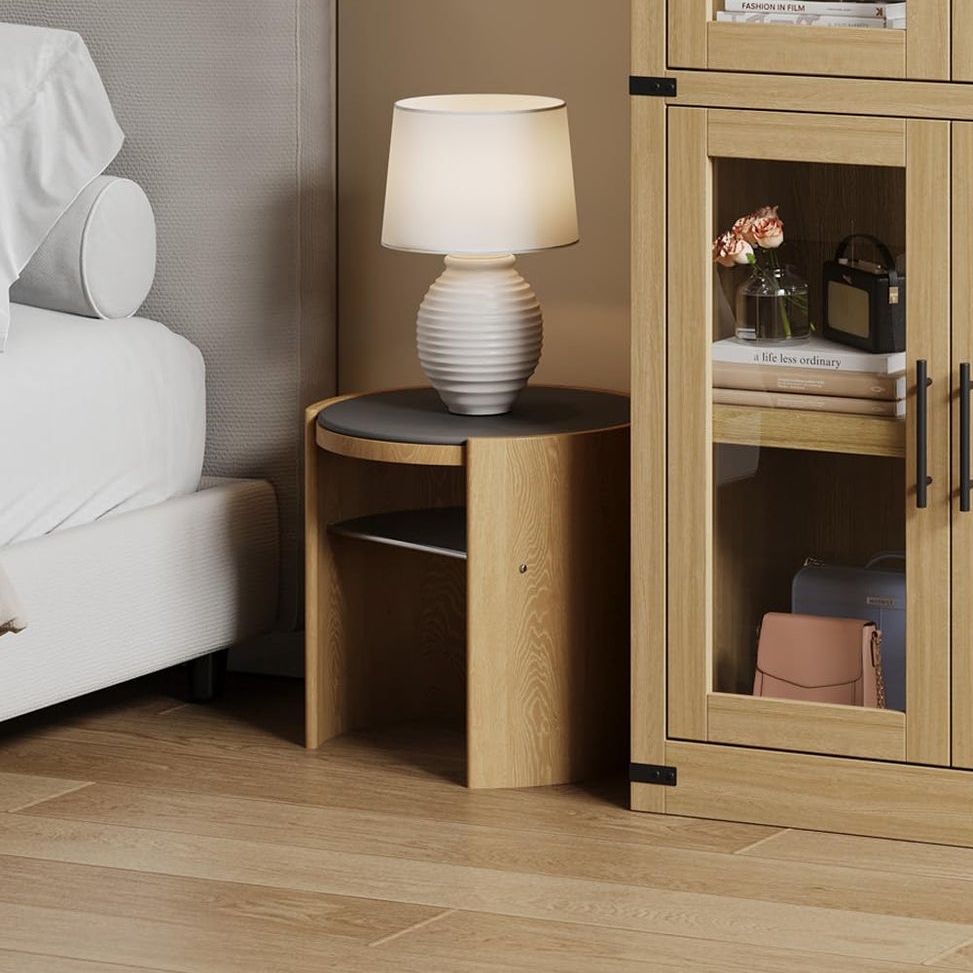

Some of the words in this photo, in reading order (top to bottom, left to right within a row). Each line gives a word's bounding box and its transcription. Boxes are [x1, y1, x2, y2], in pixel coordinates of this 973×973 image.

[741, 1, 776, 11] FASHION
[777, 3, 785, 11] IN
[787, 4, 805, 12] FILM
[762, 352, 777, 363] life
[780, 353, 797, 365] less
[799, 355, 841, 370] ordinary
